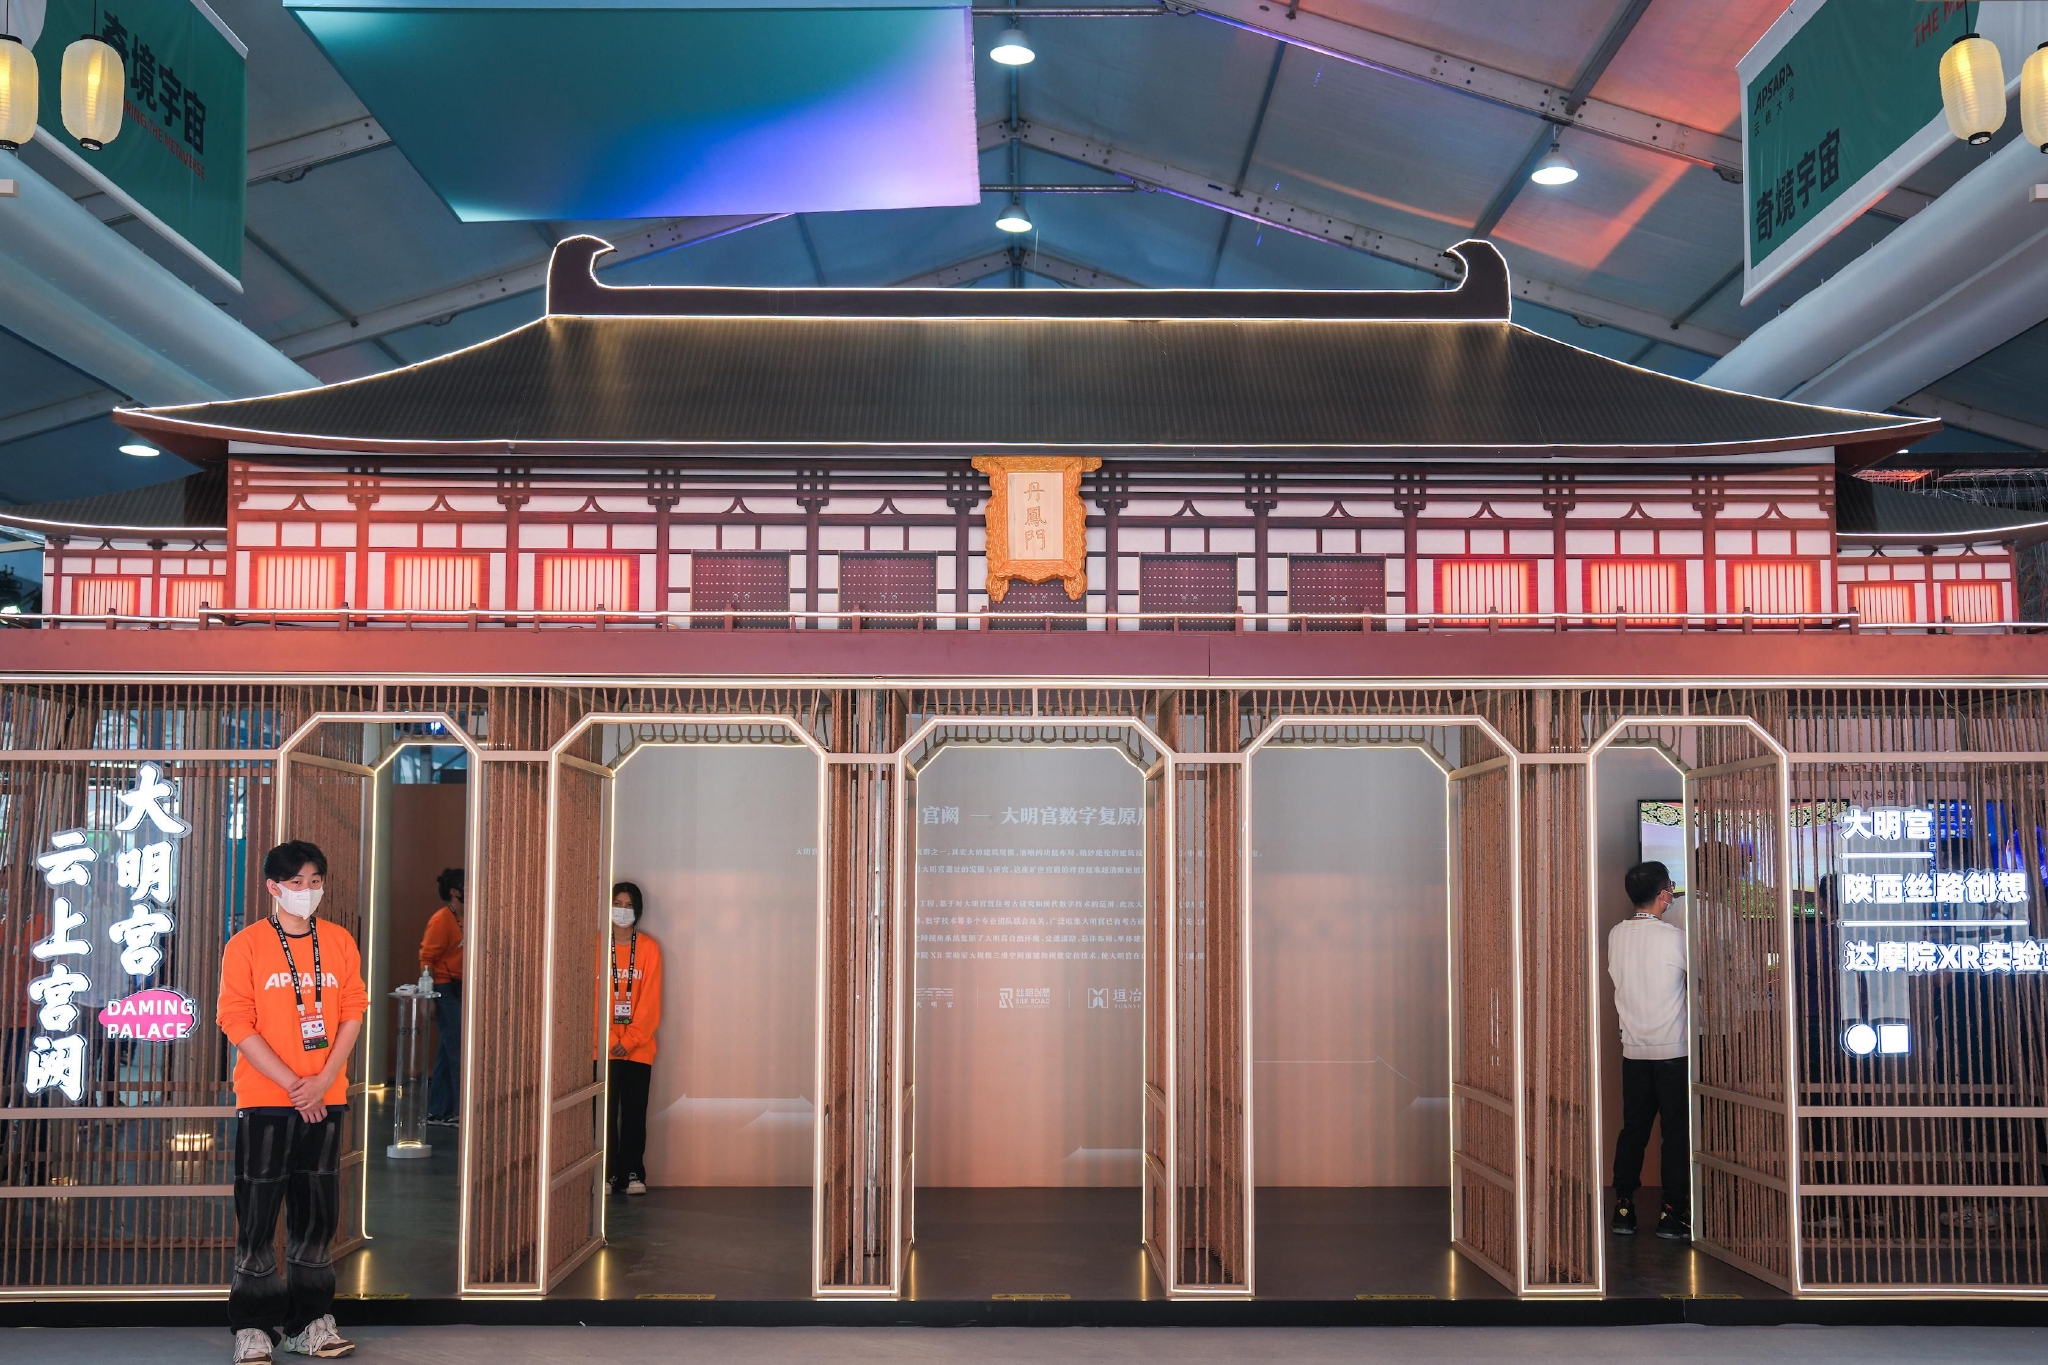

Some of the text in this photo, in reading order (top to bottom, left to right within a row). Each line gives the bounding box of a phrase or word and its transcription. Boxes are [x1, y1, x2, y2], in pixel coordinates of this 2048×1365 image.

[1914, 6, 1939, 48] THE
[102, 10, 206, 155] 奇境宇宙
[1754, 62, 1794, 116] APSARA
[1754, 87, 1794, 138] 云栖大会
[149, 118, 163, 143] THE
[164, 132, 206, 181] METAVERSE
[1756, 127, 1841, 243] 奇境宇宙
[1023, 481, 1048, 551] 丹鳳門
[918, 805, 960, 826] 宫阙
[1840, 809, 1933, 840] 大明宫
[109, 763, 188, 977] 大明宫
[1842, 873, 2028, 904] 陕西丝路创想
[25, 831, 98, 1101] 云上宫阙
[1843, 941, 2048, 972] 达摩院XR实验
[107, 999, 195, 1016] DAMING
[107, 1022, 190, 1039] PALACE
